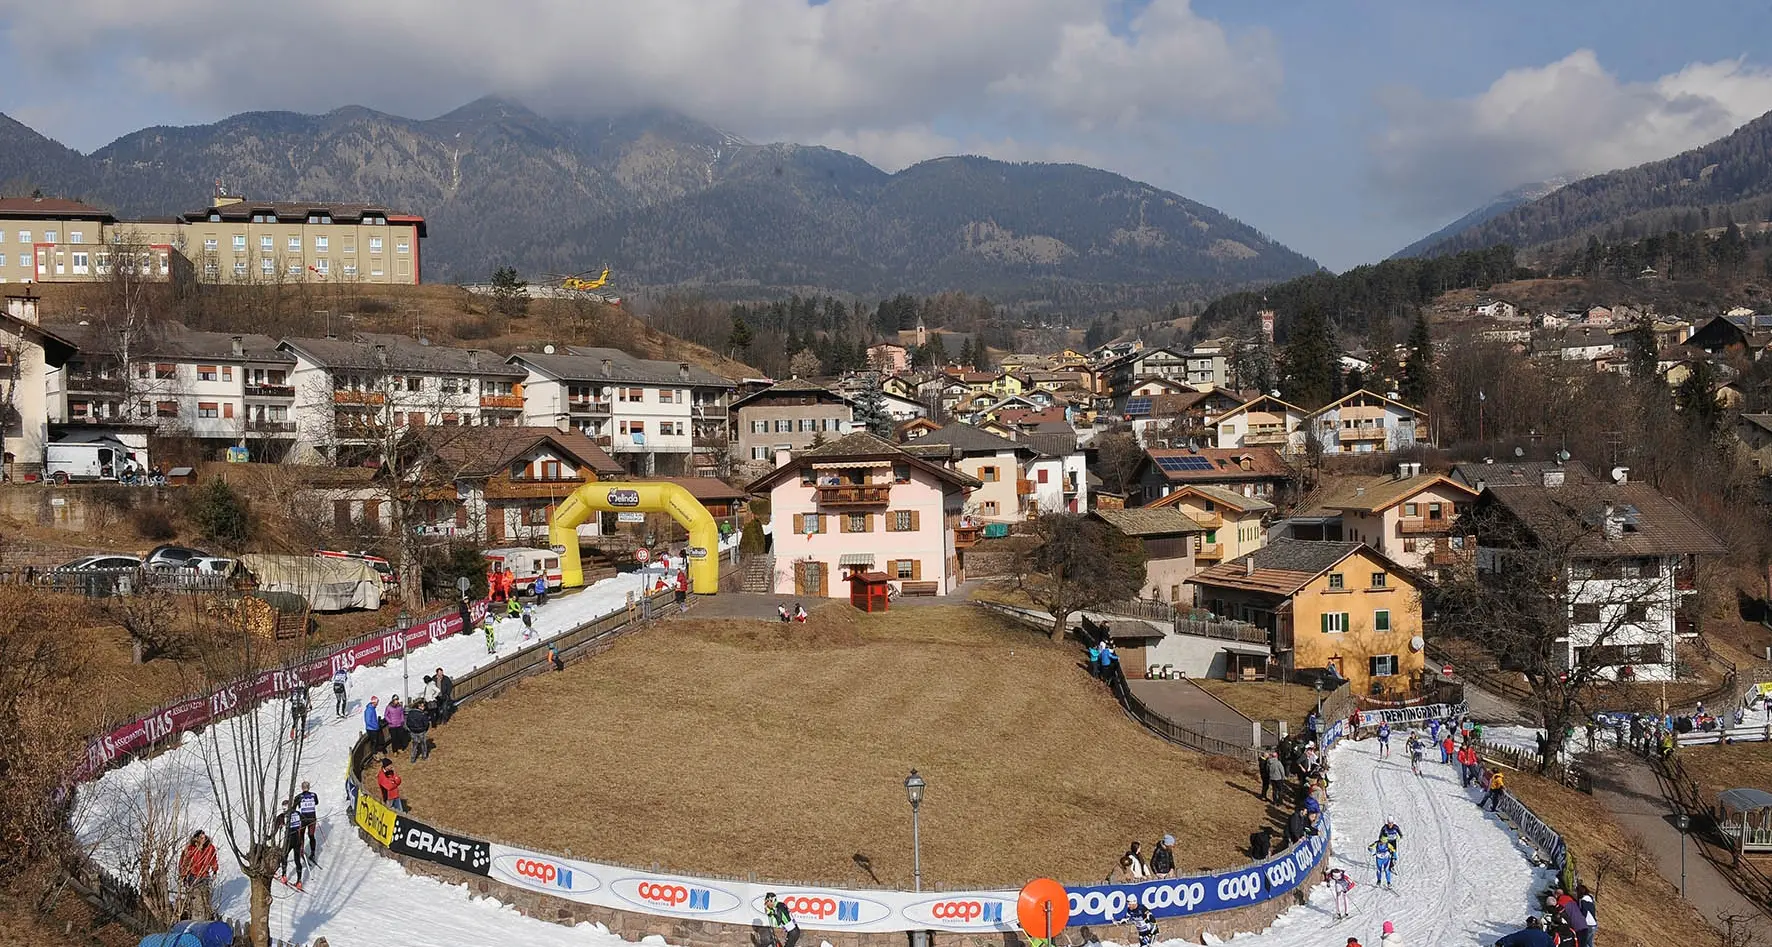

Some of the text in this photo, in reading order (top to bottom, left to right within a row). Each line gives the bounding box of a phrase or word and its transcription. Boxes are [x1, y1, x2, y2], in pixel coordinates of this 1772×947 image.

[608, 492, 638, 503] Melinda
[428, 619, 448, 639] ITAS
[383, 632, 404, 654] ITAS
[210, 685, 238, 715] TAS
[143, 710, 174, 742] ITAS
[405, 827, 472, 862] CRAFT
[516, 858, 556, 884] coop
[1266, 857, 1297, 889] coop
[638, 881, 688, 907] coop
[1141, 882, 1205, 911] coop
[1217, 871, 1261, 901] coop
[784, 896, 837, 920] coop
[932, 901, 982, 923] coop
[1068, 890, 1126, 921] oop
